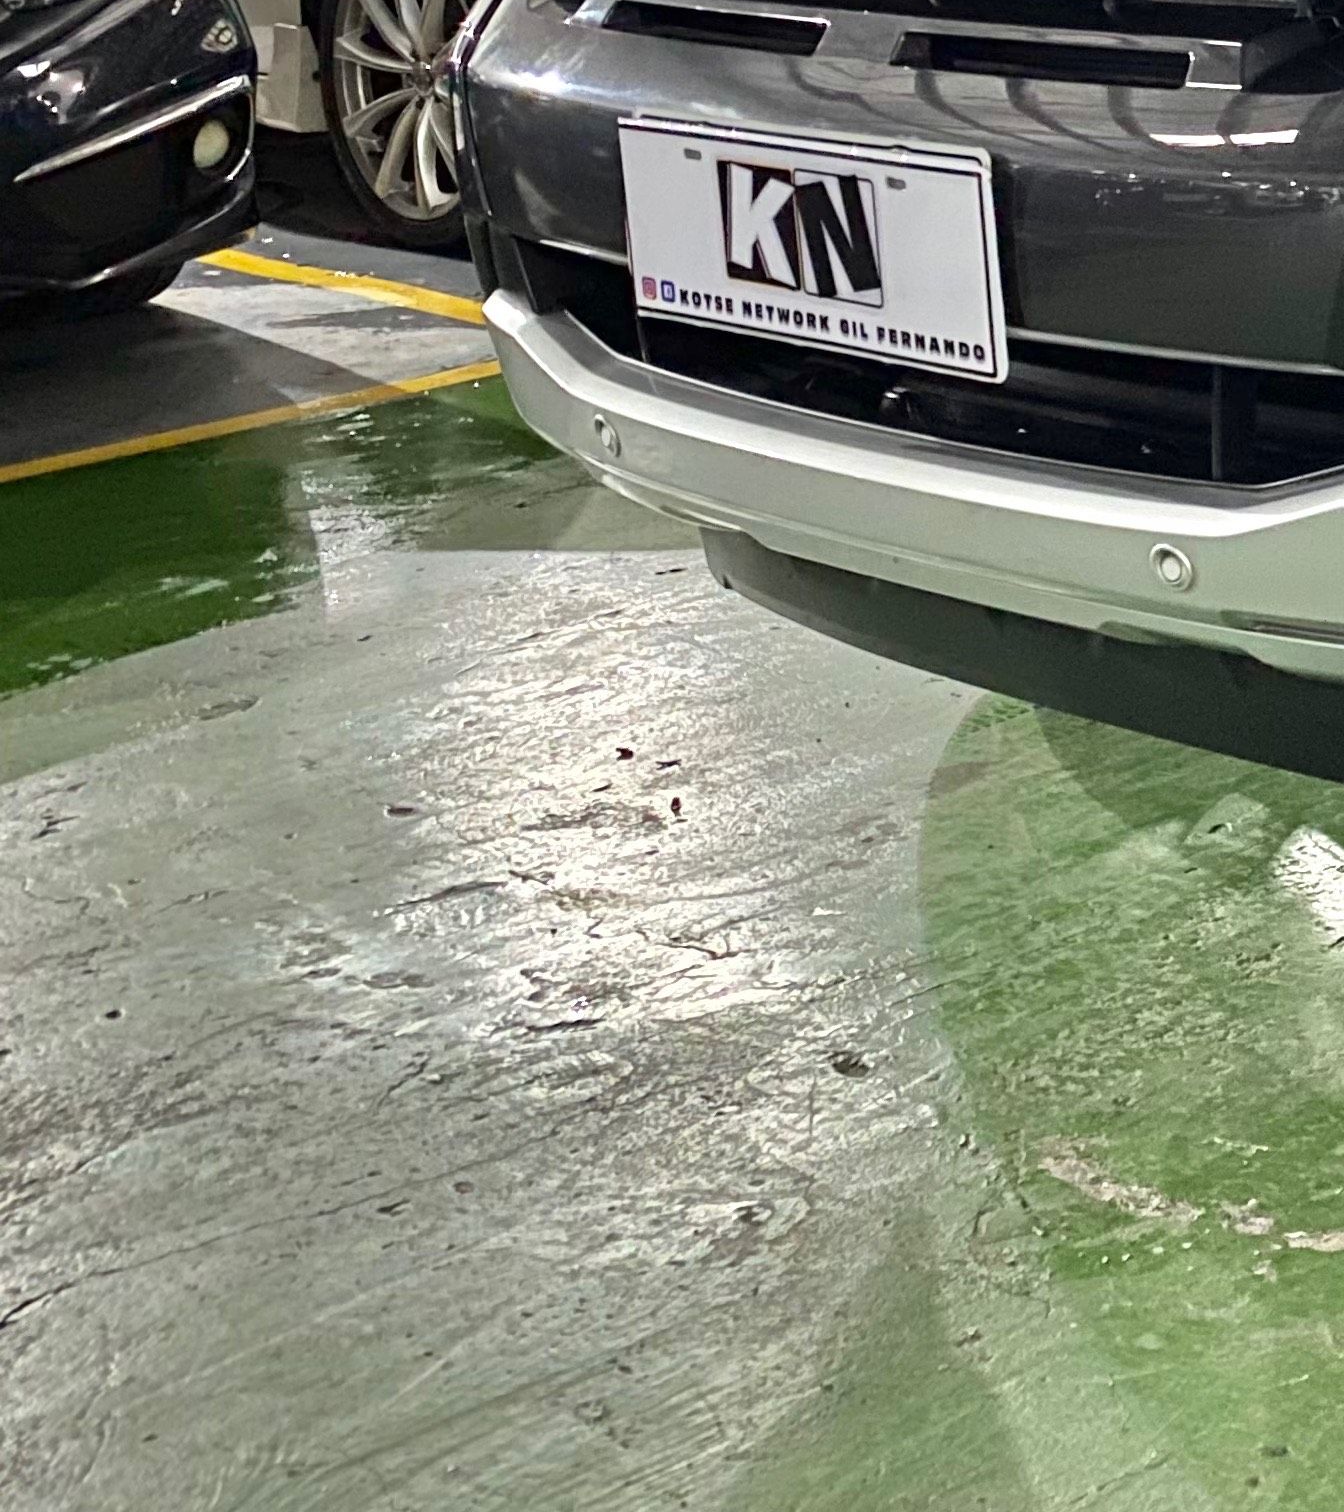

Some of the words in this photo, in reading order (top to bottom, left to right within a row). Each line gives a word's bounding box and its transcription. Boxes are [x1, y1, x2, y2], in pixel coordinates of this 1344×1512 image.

[722, 161, 882, 300] KN
[679, 288, 734, 315] KOTSE
[743, 301, 830, 331] NETWORK
[840, 319, 868, 340] GIL
[877, 326, 985, 362] FERNANDO
